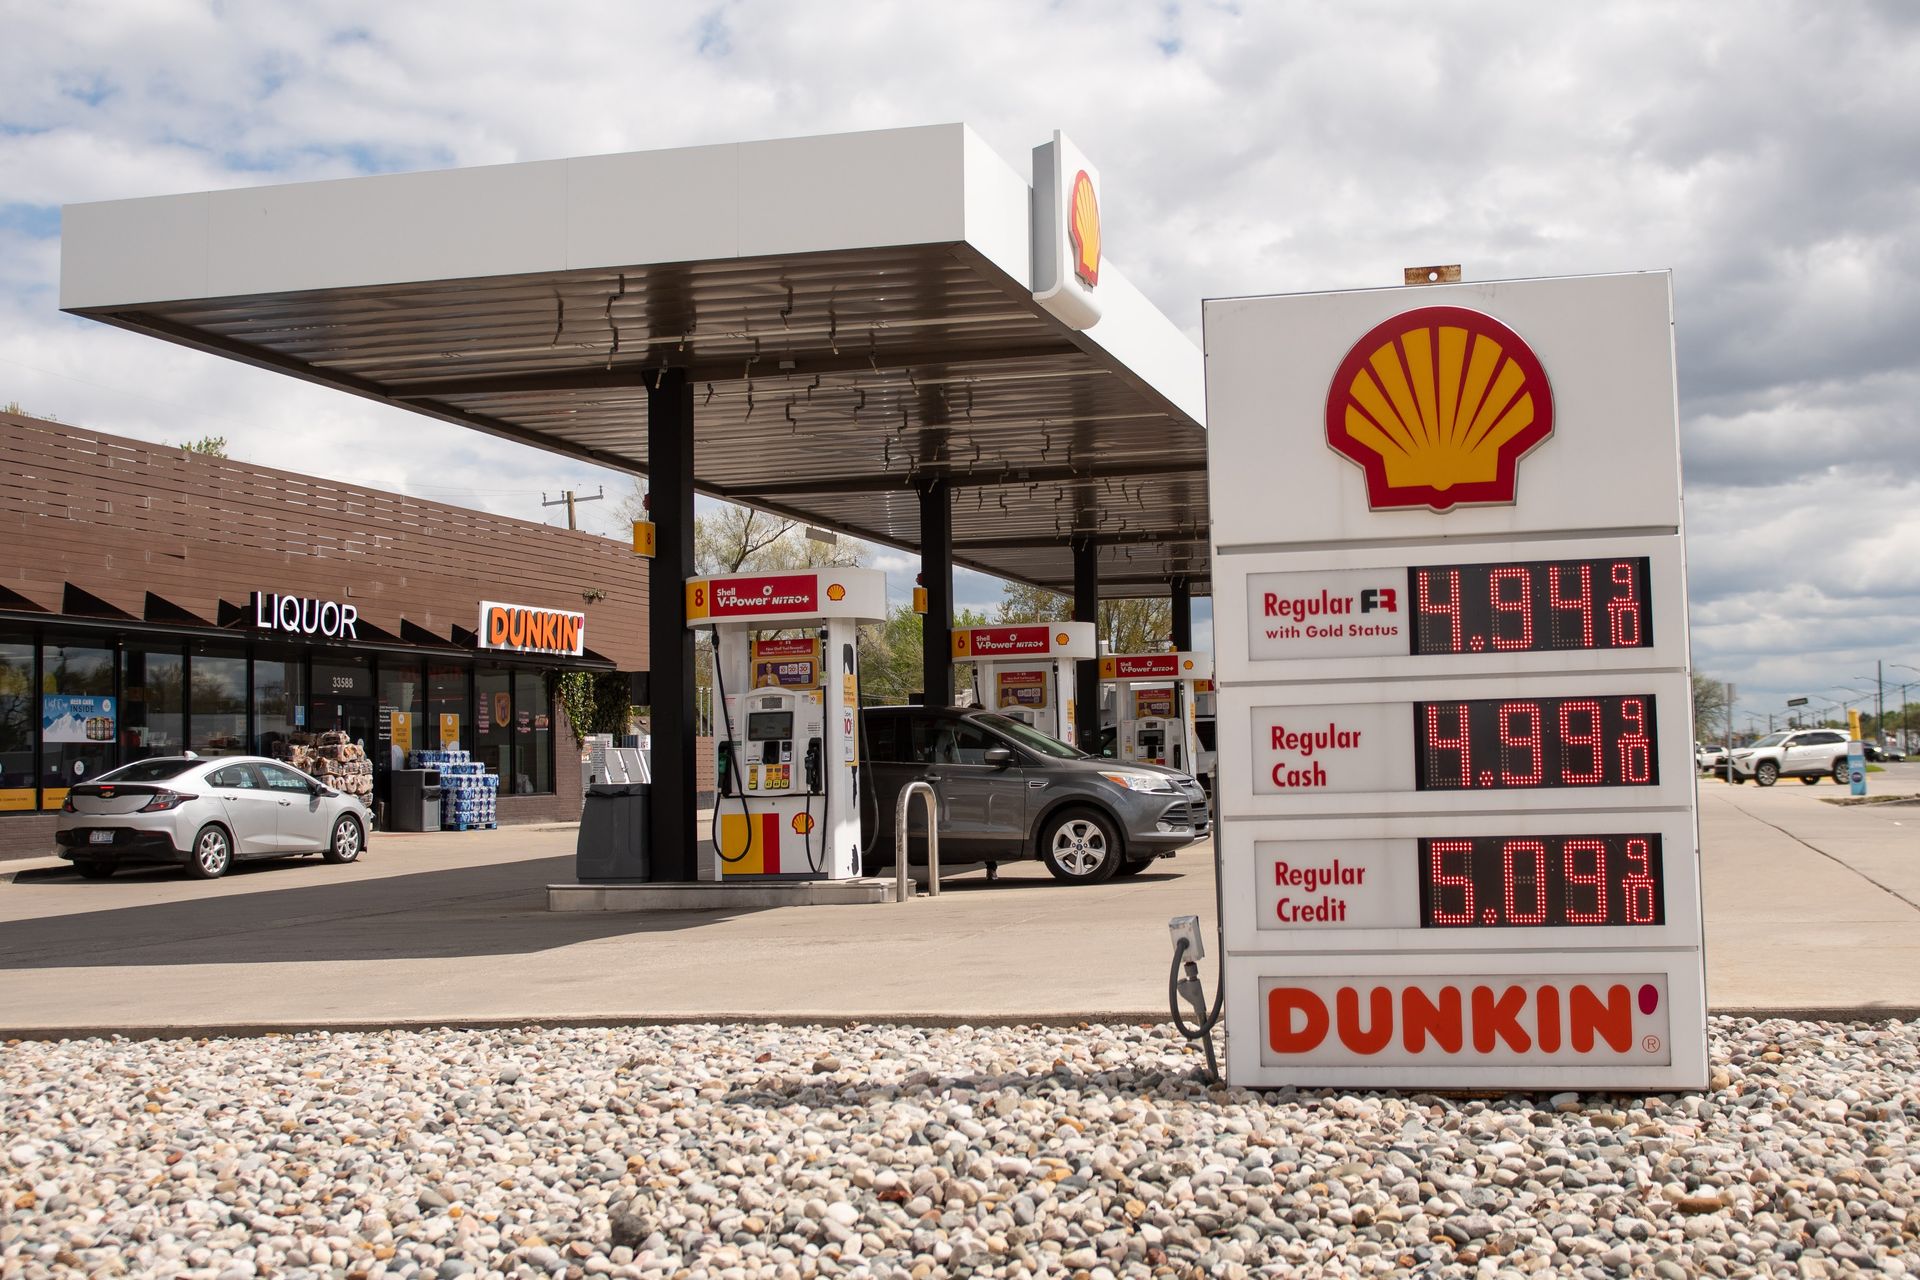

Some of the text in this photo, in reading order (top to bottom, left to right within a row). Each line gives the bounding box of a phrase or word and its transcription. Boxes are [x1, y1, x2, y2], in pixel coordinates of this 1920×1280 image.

[694, 588, 704, 607] 8
[717, 587, 736, 597] Shell
[717, 596, 768, 608] V-Power
[1264, 589, 1354, 622] Regular
[257, 591, 357, 639] LIQUOR
[488, 607, 583, 652] DUNKIN'
[1266, 624, 1398, 639] with Gold Status
[957, 635, 966, 649] 6
[976, 641, 1014, 650] V-Power
[1105, 662, 1112, 672] 4
[332, 676, 354, 689] 33588
[70, 705, 95, 713] INSIDE
[1271, 723, 1361, 756] Regular
[1272, 761, 1327, 787] Cash
[1275, 859, 1366, 892] Regular
[1276, 896, 1346, 922] Credit
[1268, 984, 1659, 1055] DUNKIN'
